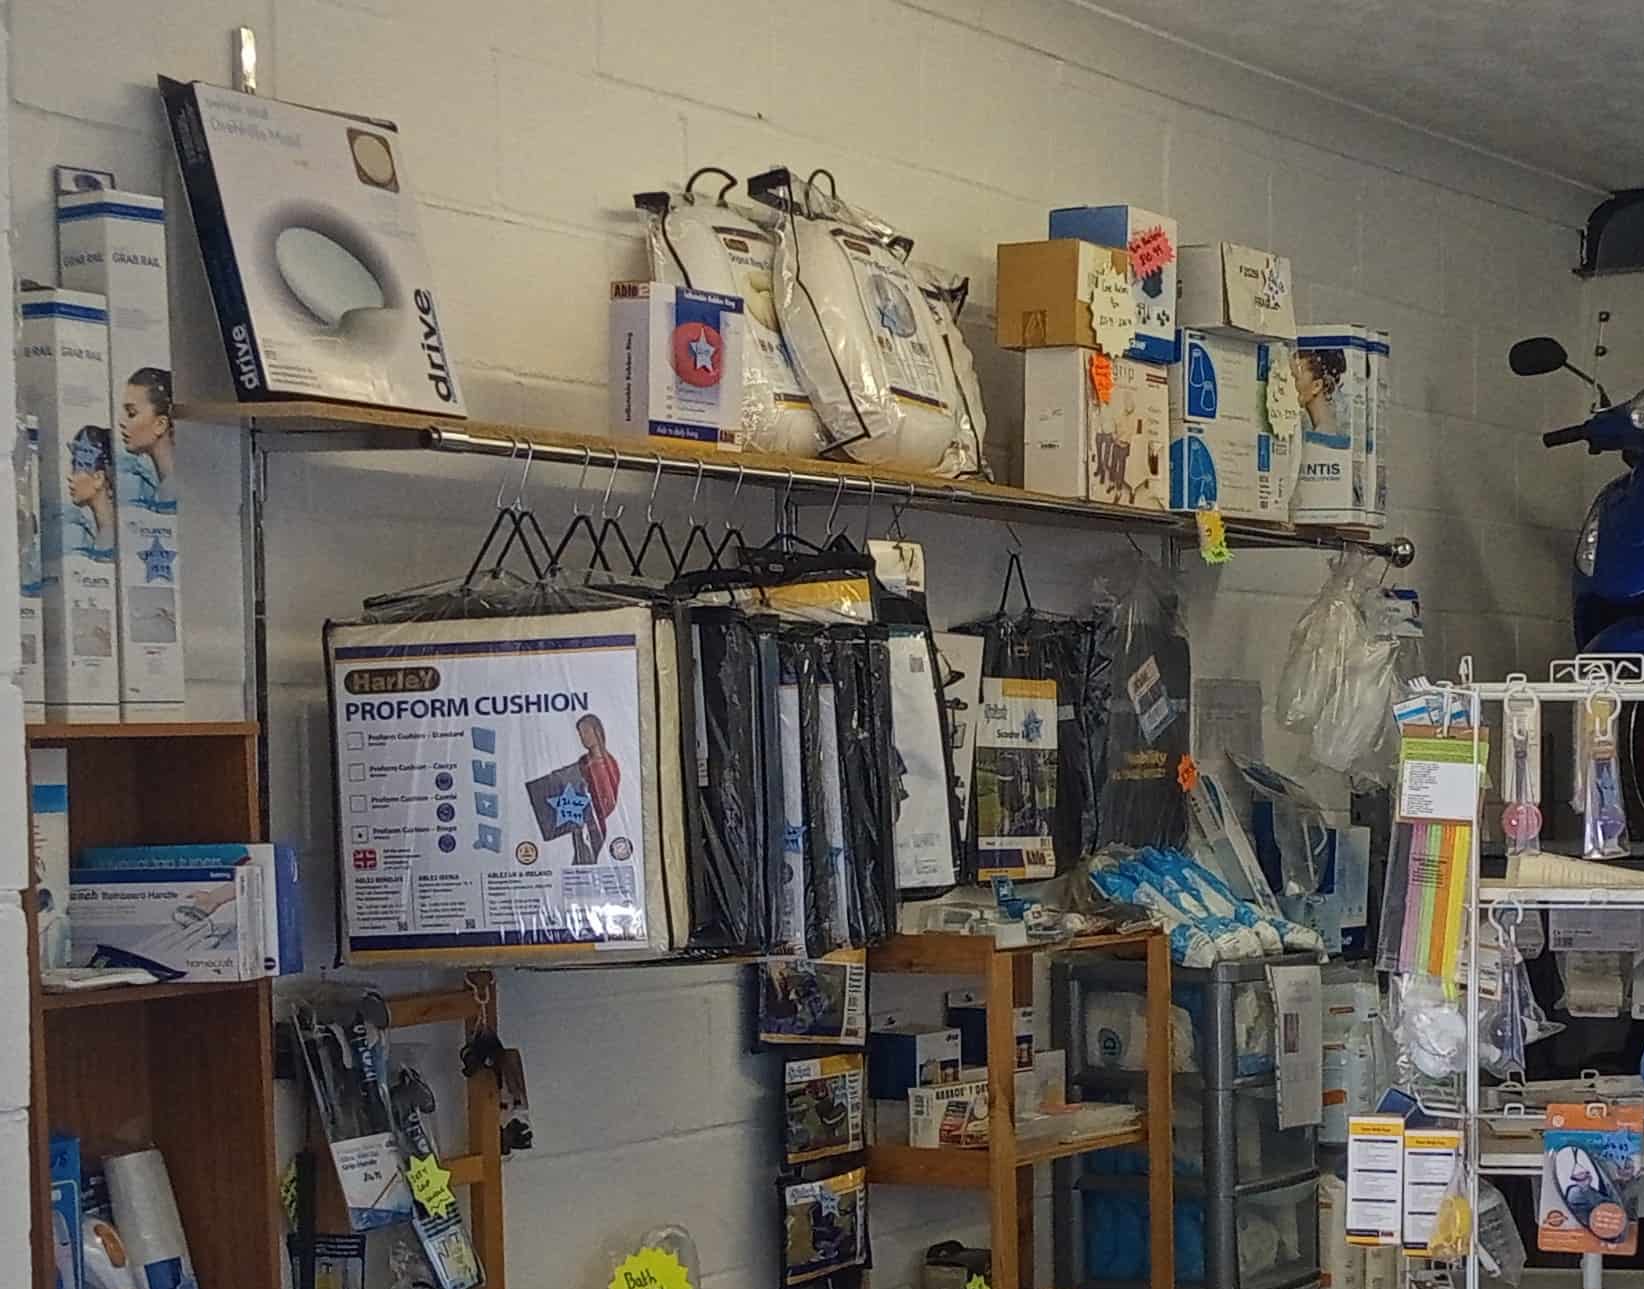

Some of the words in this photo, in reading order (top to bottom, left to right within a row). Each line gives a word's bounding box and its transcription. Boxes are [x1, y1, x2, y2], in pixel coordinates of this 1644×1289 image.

[112, 252, 139, 266] GRAB
[140, 256, 161, 269] RAIL
[233, 323, 262, 390] drive
[413, 286, 460, 405] drive
[345, 698, 469, 722] PROFORM
[474, 692, 589, 717] CUSHION
